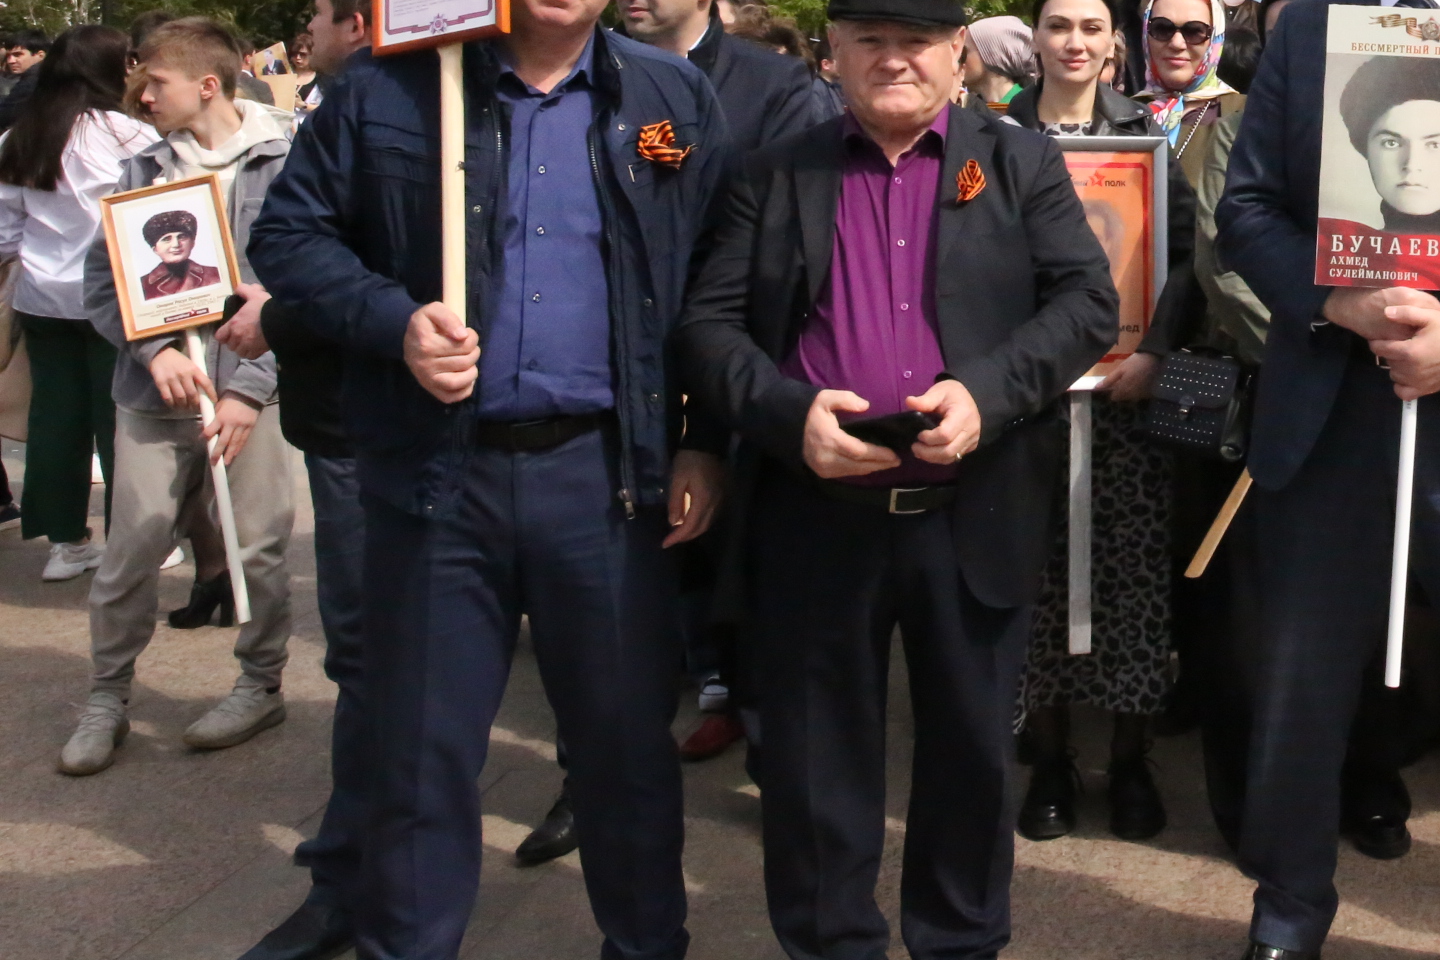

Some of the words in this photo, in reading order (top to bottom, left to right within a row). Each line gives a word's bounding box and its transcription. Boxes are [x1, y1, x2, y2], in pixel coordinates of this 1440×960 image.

[1351, 42, 1429, 55] БЕССМЕРТНЫЙ
[1331, 234, 1440, 257] БУЧАЕВ
[1330, 255, 1369, 268] АХМЕД
[1329, 268, 1418, 282] СУЛЕЙМАНОВИЧ
